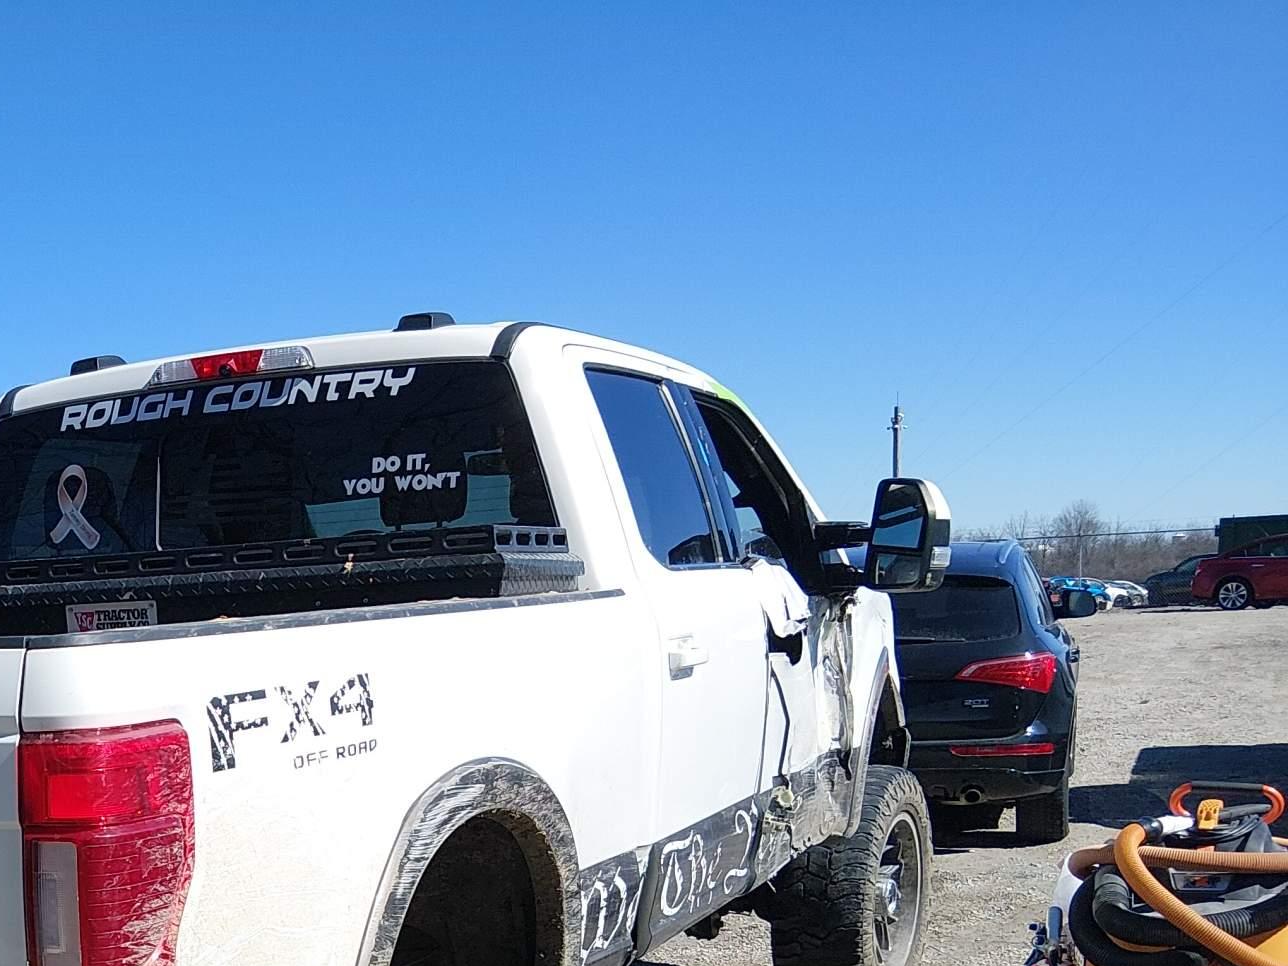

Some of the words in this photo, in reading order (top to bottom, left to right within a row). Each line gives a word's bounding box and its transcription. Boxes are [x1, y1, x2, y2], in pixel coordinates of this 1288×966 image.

[61, 390, 194, 432] ROUGH
[203, 367, 416, 414] COUNTRY
[372, 455, 401, 473] DO
[406, 453, 431, 472] IT,
[343, 477, 385, 495] YOU
[394, 471, 461, 492] WON'T
[95, 608, 150, 622] TRACTOR
[206, 672, 374, 773] FX4
[293, 750, 329, 769] OFF
[336, 739, 377, 759] ROAD
